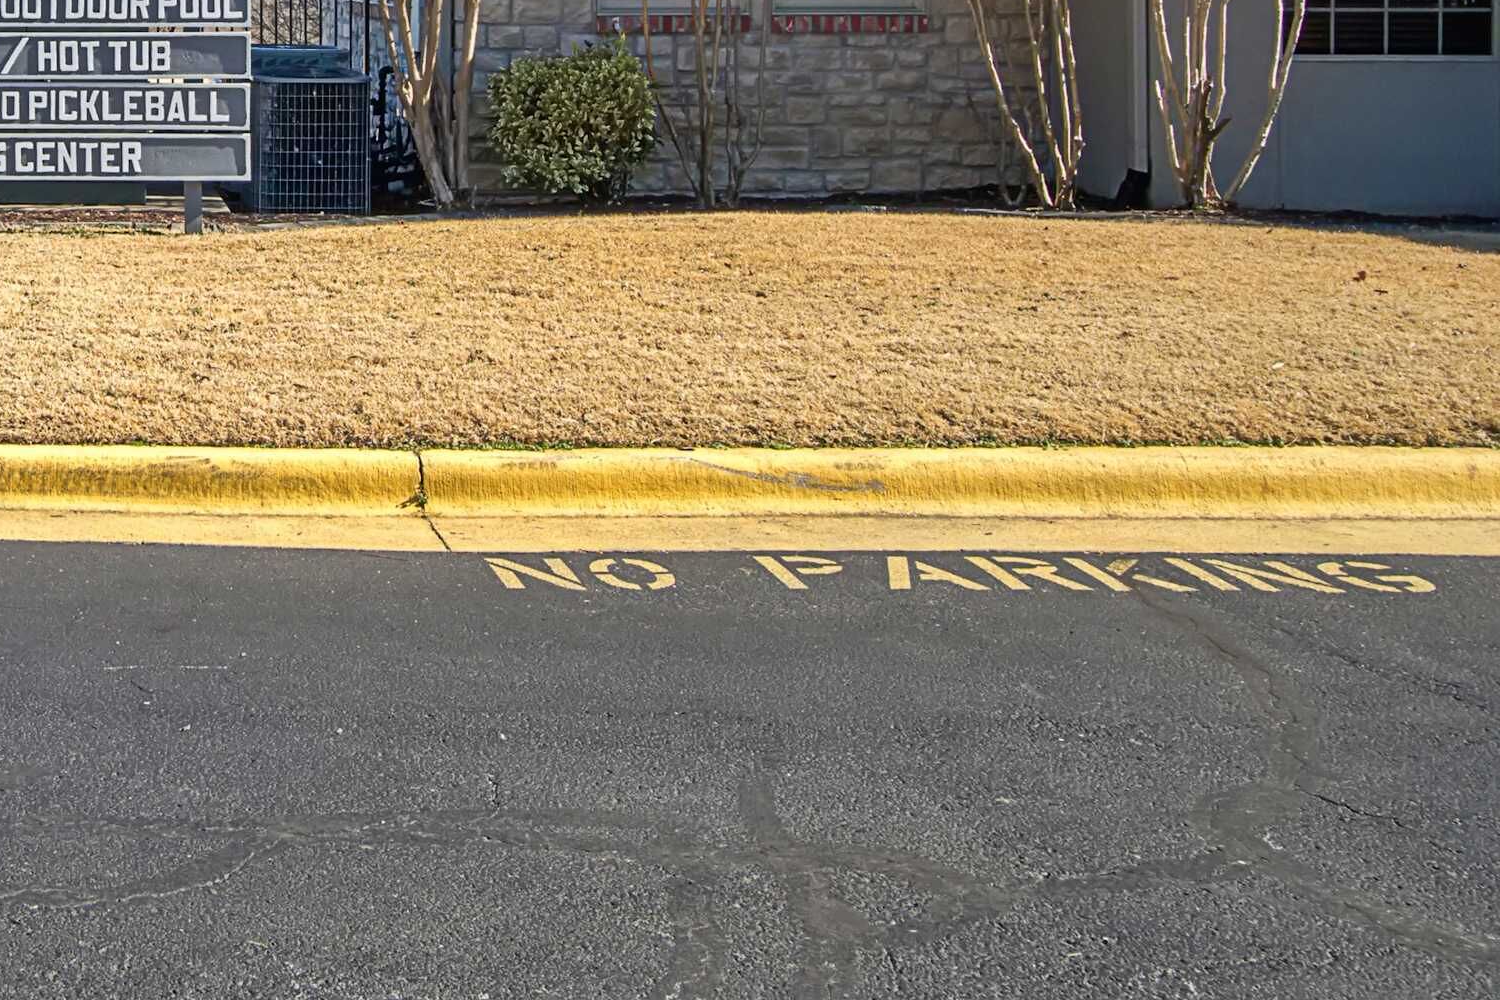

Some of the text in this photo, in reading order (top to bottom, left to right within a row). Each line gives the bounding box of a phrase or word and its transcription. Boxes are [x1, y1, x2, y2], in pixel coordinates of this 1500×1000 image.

[1, 36, 30, 75] /
[37, 40, 100, 72] HOT
[108, 40, 171, 72] TUB
[28, 89, 231, 123] PICKLEBALL
[14, 141, 142, 173] CENTER
[483, 554, 1437, 594] NO PARKING
